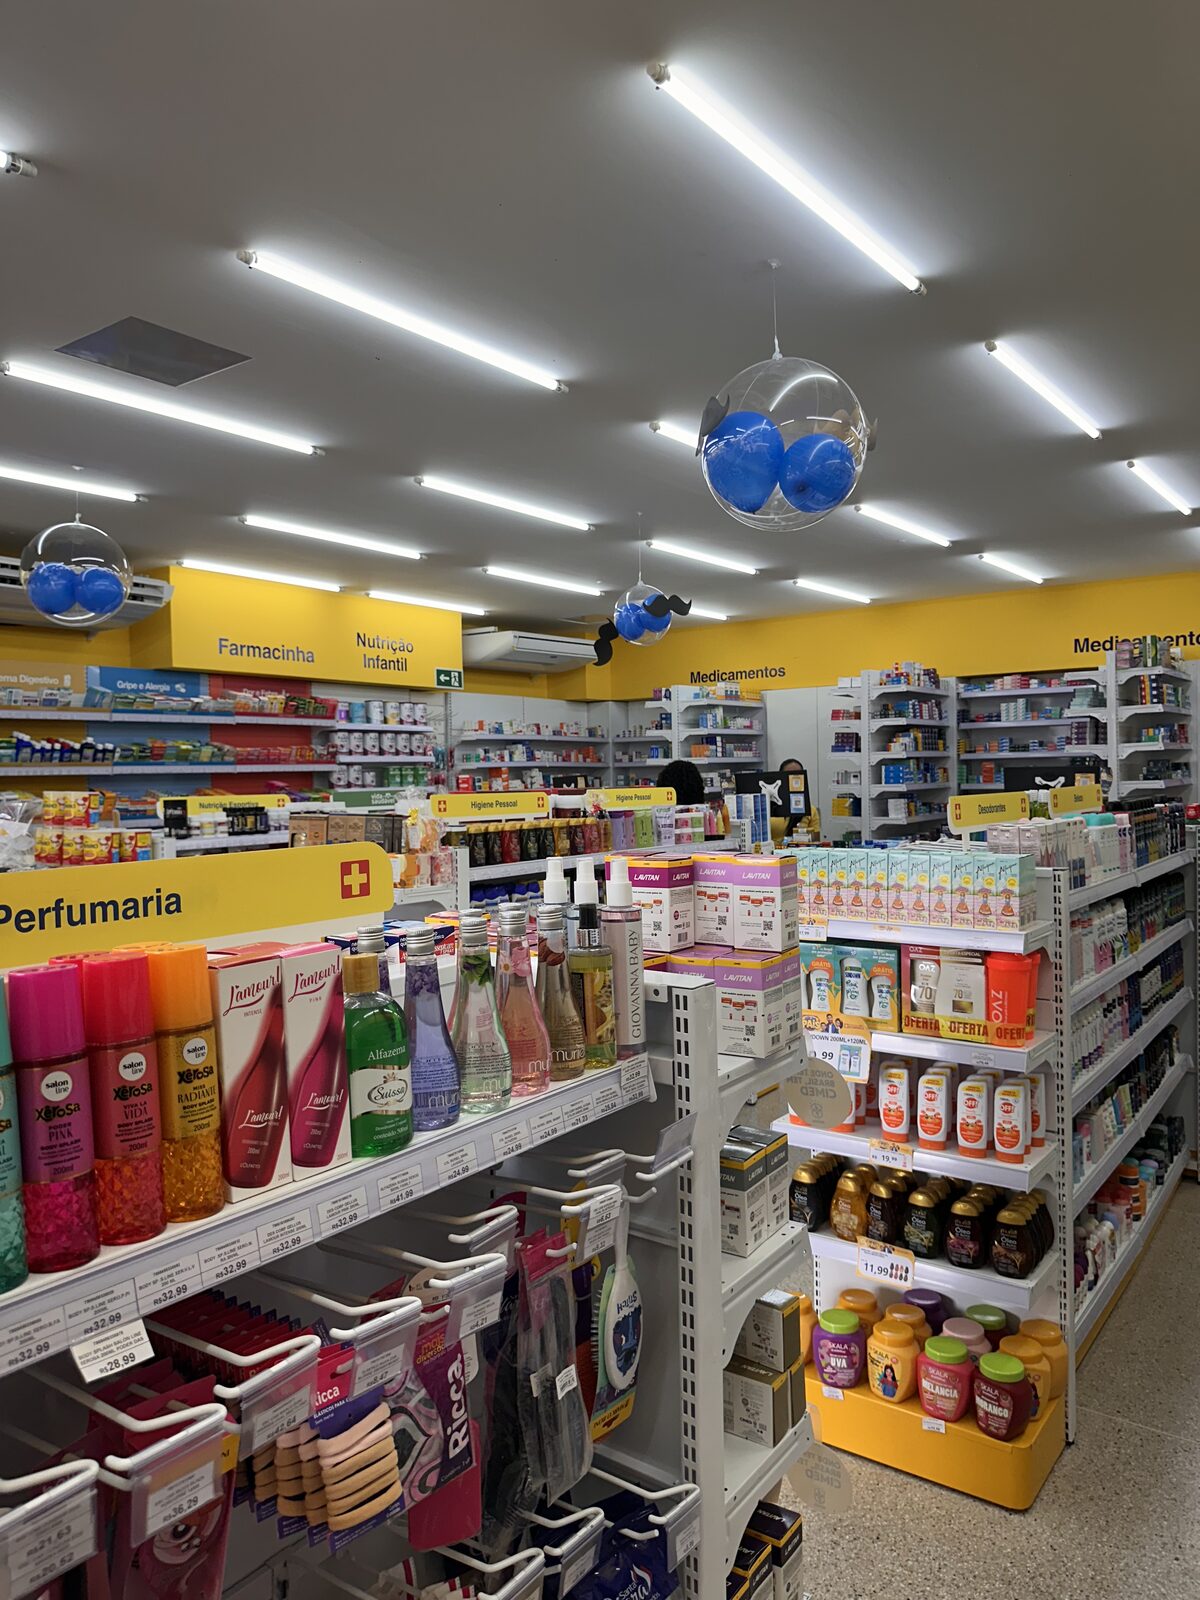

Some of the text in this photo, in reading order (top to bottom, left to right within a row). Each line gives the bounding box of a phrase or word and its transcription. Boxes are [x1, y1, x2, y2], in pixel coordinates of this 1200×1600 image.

[218, 638, 315, 663] Farmacinha
[356, 632, 414, 655] Nutrição
[363, 654, 408, 672] Infantil
[19, 674, 59, 685] Digestivo
[690, 666, 786, 684] Medicamentos
[116, 680, 137, 691] Gripe
[145, 682, 170, 693] Alergia
[470, 799, 518, 810] Higiene Pessoal
[978, 803, 1006, 815] Desodorantes
[633, 873, 660, 881] LAVITAN
[672, 872, 690, 881] LAVITAN
[699, 868, 726, 876] LAVITAN
[0, 888, 182, 934] Perfumaria
[629, 929, 641, 1039] GIOVANNA BABY
[723, 973, 753, 983] LAVITAN
[919, 985, 933, 1000] 70
[243, 1008, 263, 1018] INTENSE
[904, 1015, 940, 1032] OFERTA
[949, 1021, 989, 1037] OFERTA
[186, 1045, 206, 1054] salon
[194, 1051, 206, 1060] line
[367, 1045, 406, 1061] Alfazema
[123, 1060, 144, 1070] salon
[131, 1066, 144, 1075] line
[46, 1078, 69, 1089] salon
[55, 1085, 69, 1094] line
[963, 1099, 980, 1108] OFF!
[1000, 1104, 1016, 1113] OFF!
[124, 1107, 148, 1120] VIDA
[48, 1128, 73, 1142] PINK
[447, 1165, 469, 1181] R$24,99
[390, 1189, 414, 1205] R$41,99
[331, 1213, 358, 1231] R$32,99
[272, 1236, 301, 1255] R$32,99
[215, 1259, 247, 1280] R$32,99
[864, 1261, 889, 1277] 11,99
[153, 1283, 188, 1306] R$32,99
[84, 1312, 122, 1336] R$32,99
[827, 1341, 848, 1351] SKALA
[8, 1341, 50, 1367] R$32,99
[99, 1352, 136, 1375] R$28,99
[830, 1357, 847, 1369] UVA
[928, 1366, 949, 1379] SKALA
[922, 1378, 958, 1398] MELANCIA
[447, 1353, 470, 1459] Ricca
[163, 1496, 199, 1523] R$36,29
[619, 1582, 637, 1600] Santa
